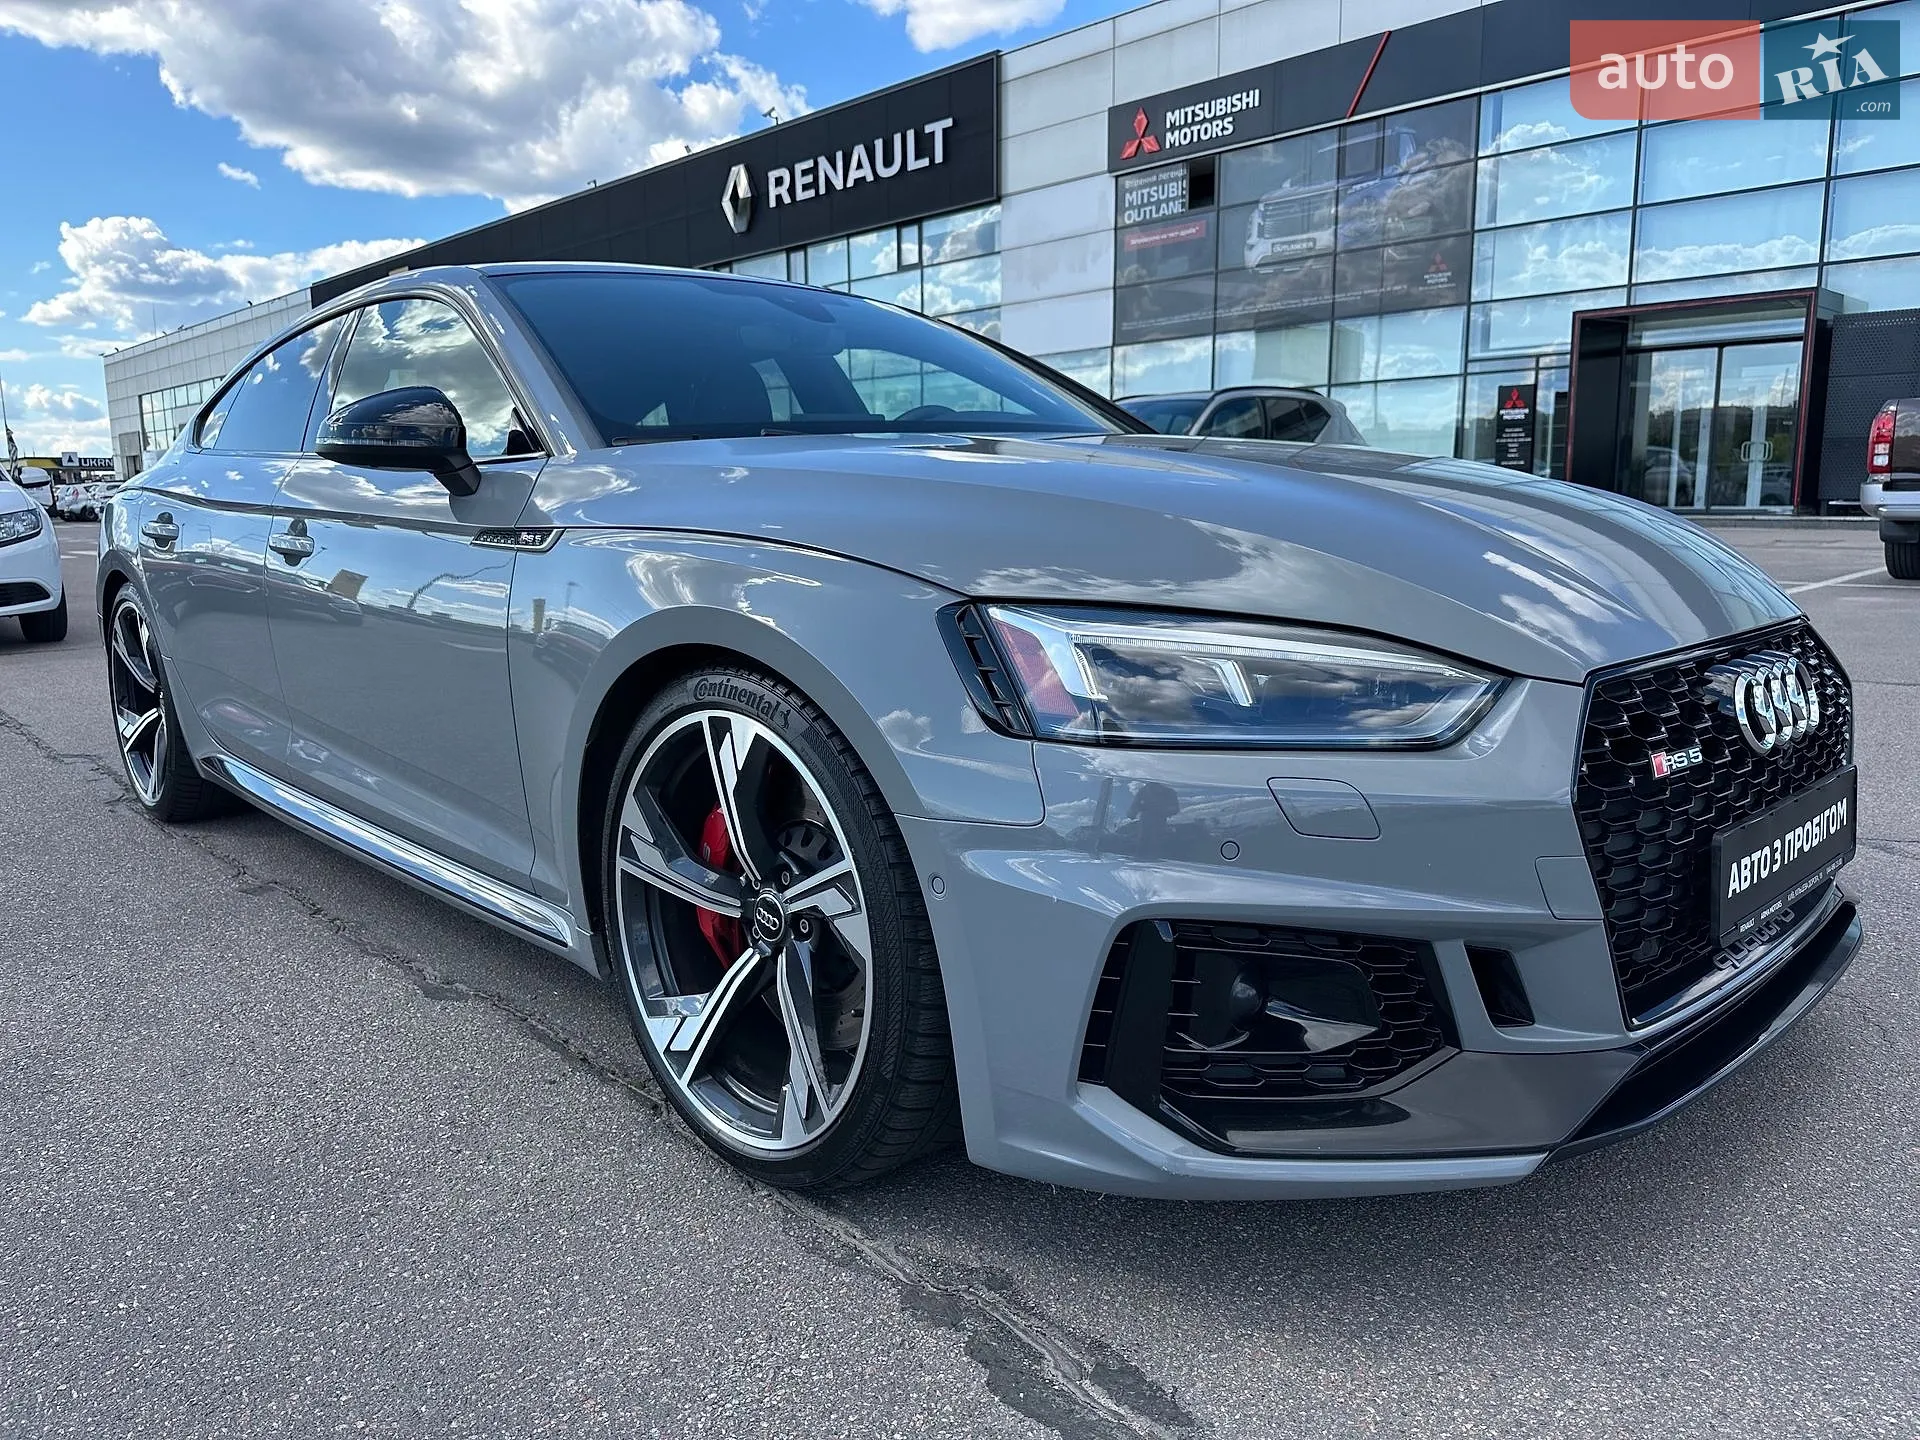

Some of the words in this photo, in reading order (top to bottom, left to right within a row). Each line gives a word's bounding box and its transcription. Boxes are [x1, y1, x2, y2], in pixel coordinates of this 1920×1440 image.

[1165, 89, 1260, 129] MITSUBISHI
[1165, 117, 1234, 149] MOTORS
[767, 117, 953, 209] RENAULT
[693, 677, 782, 722] Continental
[1727, 845, 1771, 899] АВТО
[1784, 797, 1847, 865] ПРОБІГОМ
